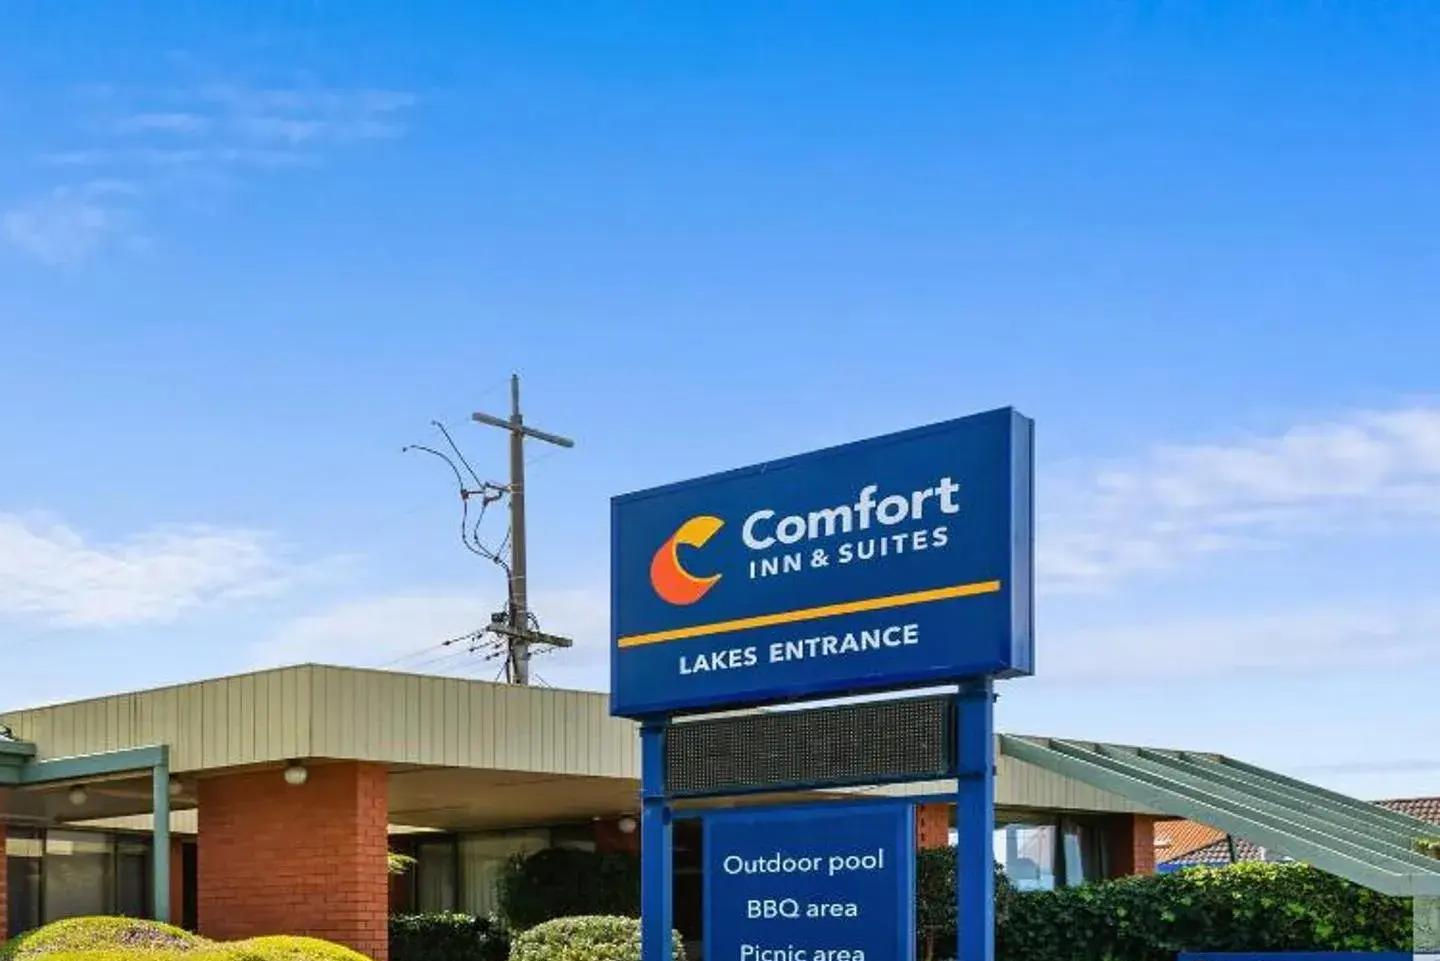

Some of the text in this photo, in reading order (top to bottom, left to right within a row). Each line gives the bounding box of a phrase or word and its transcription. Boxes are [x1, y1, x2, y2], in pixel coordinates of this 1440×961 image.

[742, 476, 960, 550] Comfort
[749, 526, 949, 579] INN & SUITES
[679, 623, 919, 675] LAKES ENTRANCE
[723, 848, 884, 876] Outdoor pool
[747, 898, 858, 919] BBQ area
